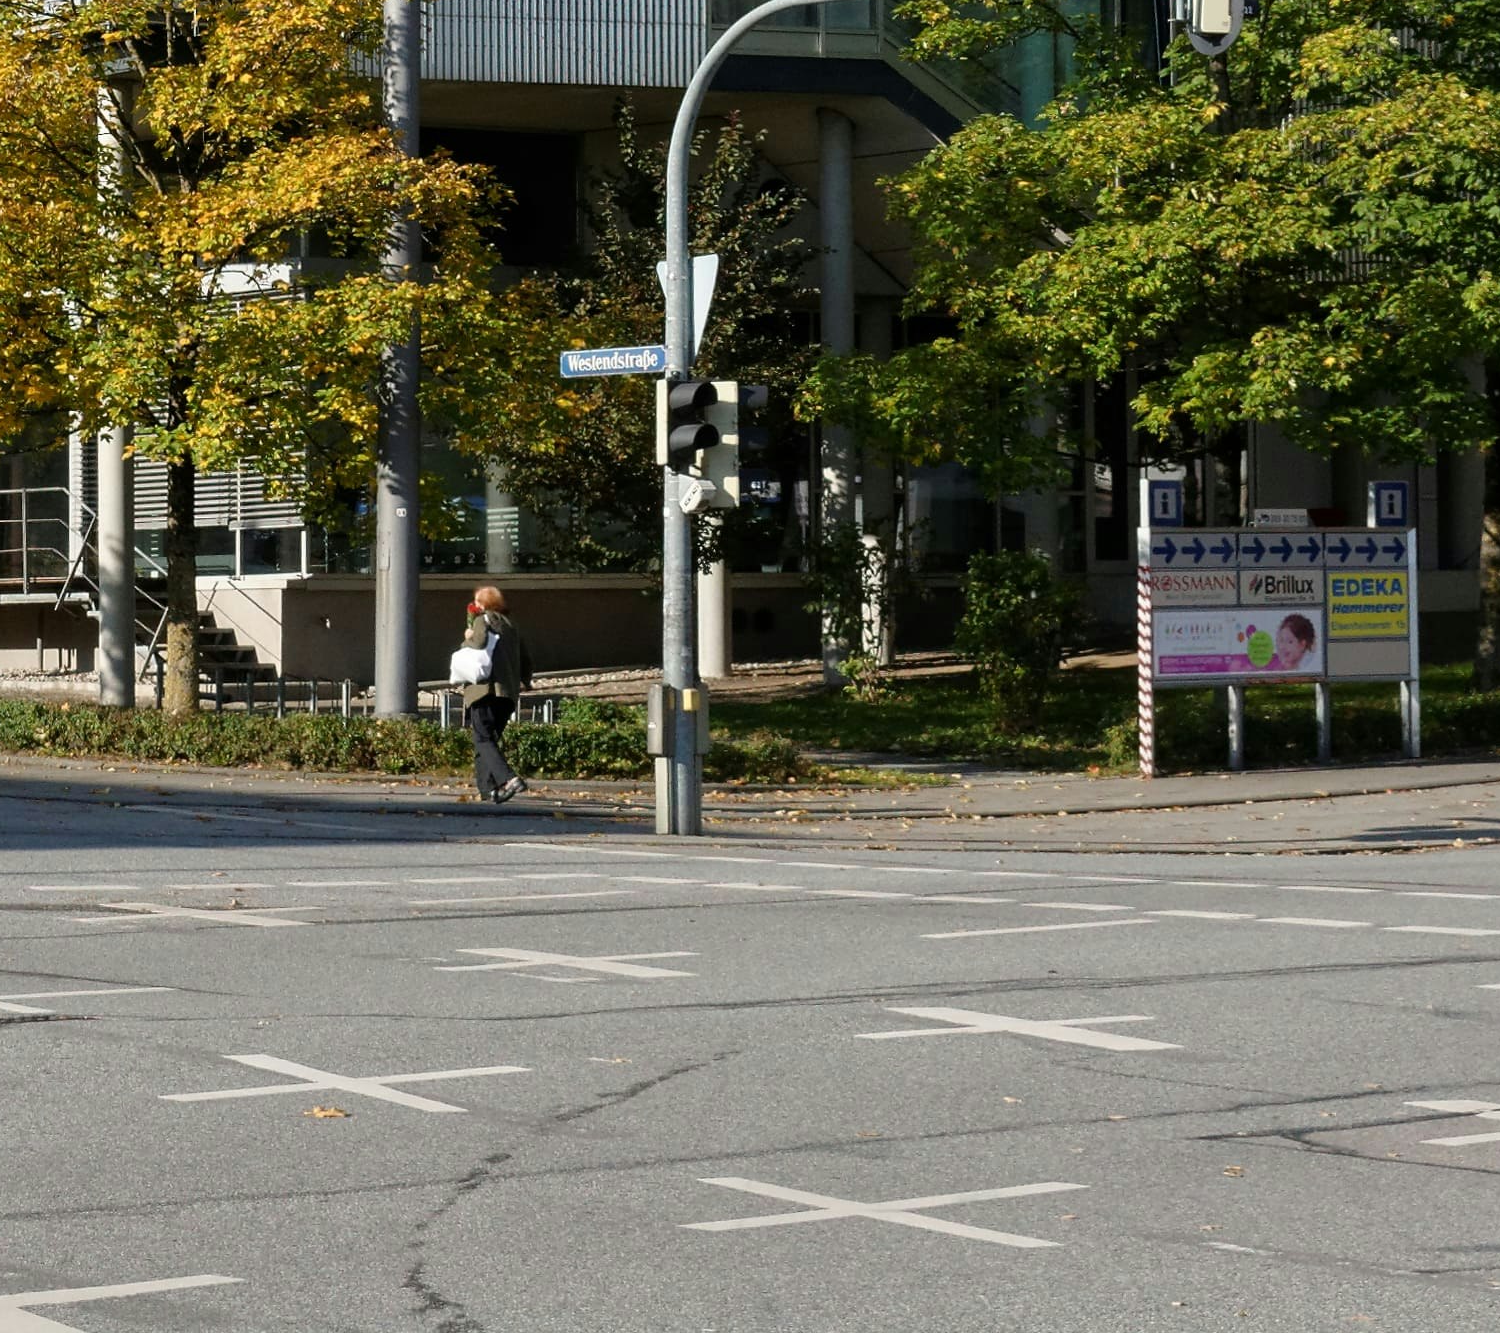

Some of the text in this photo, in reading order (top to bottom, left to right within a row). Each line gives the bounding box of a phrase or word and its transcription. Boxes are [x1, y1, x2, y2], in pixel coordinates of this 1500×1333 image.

[567, 350, 658, 372] Westendstraße
[1151, 575, 1237, 592] ROSSMANN
[1264, 574, 1314, 595] Brillux
[1332, 578, 1404, 597] EDEKA
